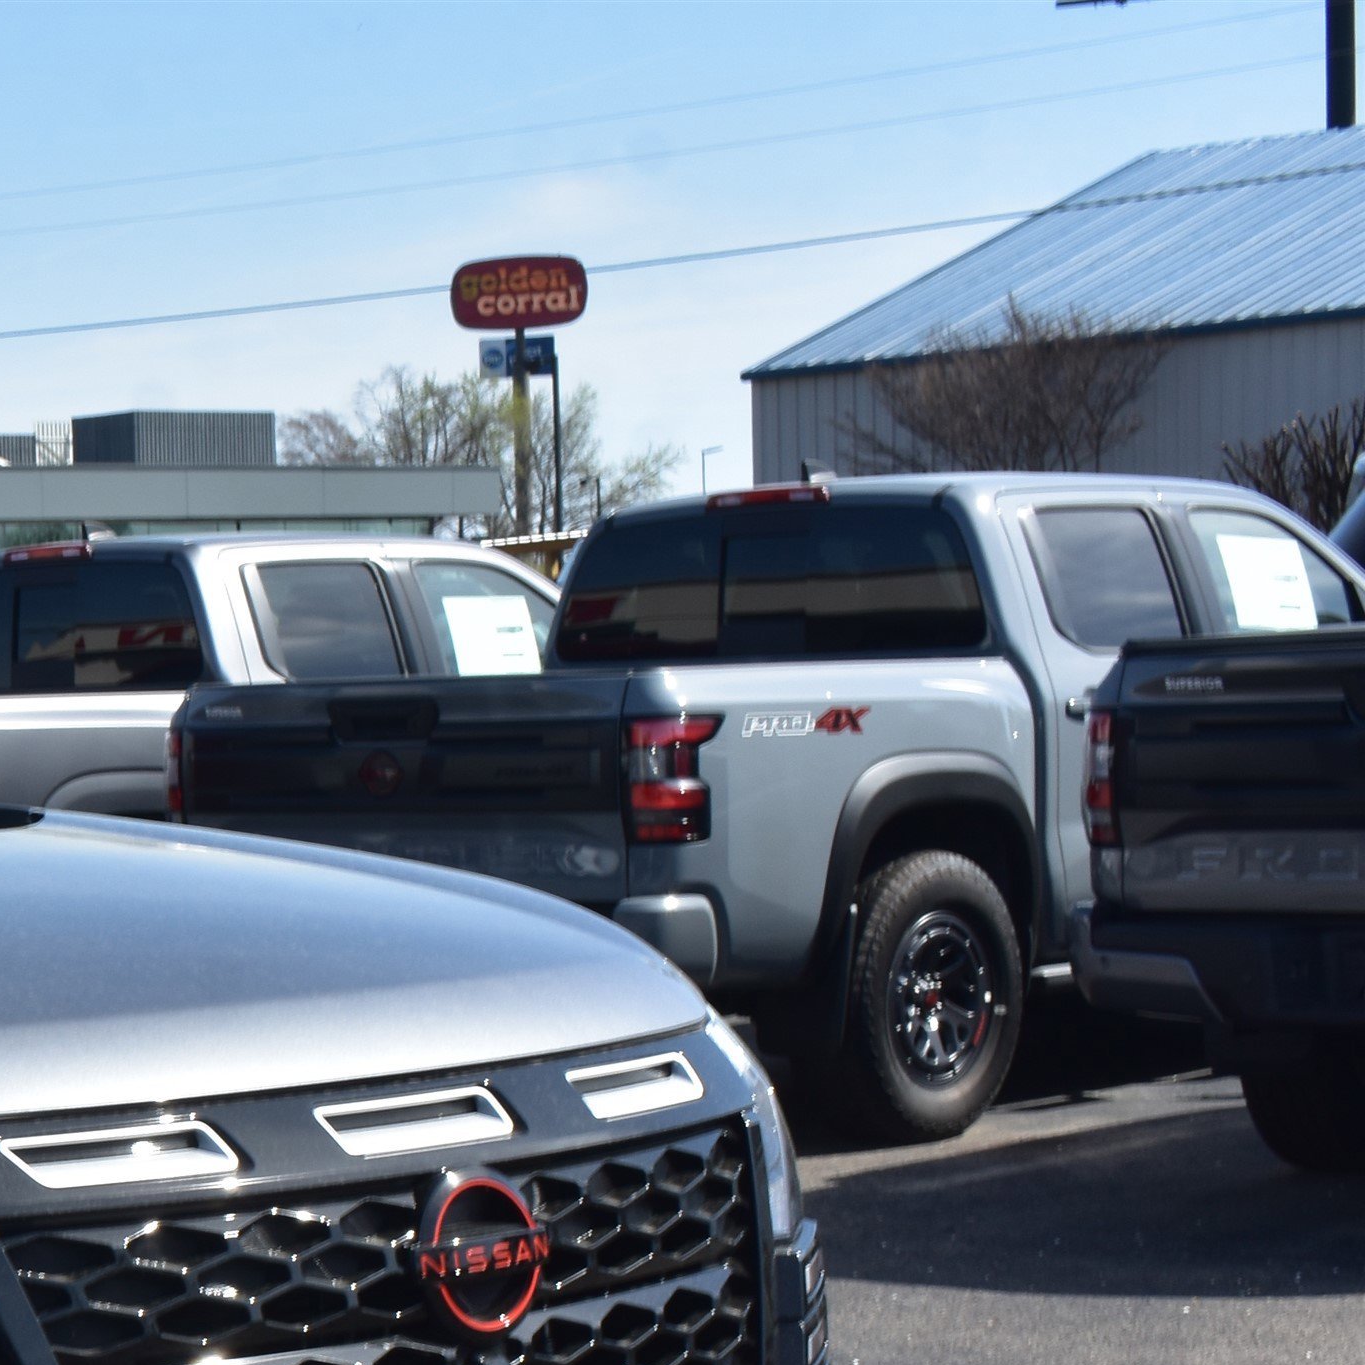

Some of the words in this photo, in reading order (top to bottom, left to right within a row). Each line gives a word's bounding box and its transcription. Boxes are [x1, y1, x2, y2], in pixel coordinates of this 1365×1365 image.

[476, 285, 580, 317] corral
[1165, 675, 1224, 692] SUPERIOR
[420, 1233, 550, 1279] NISSAN
